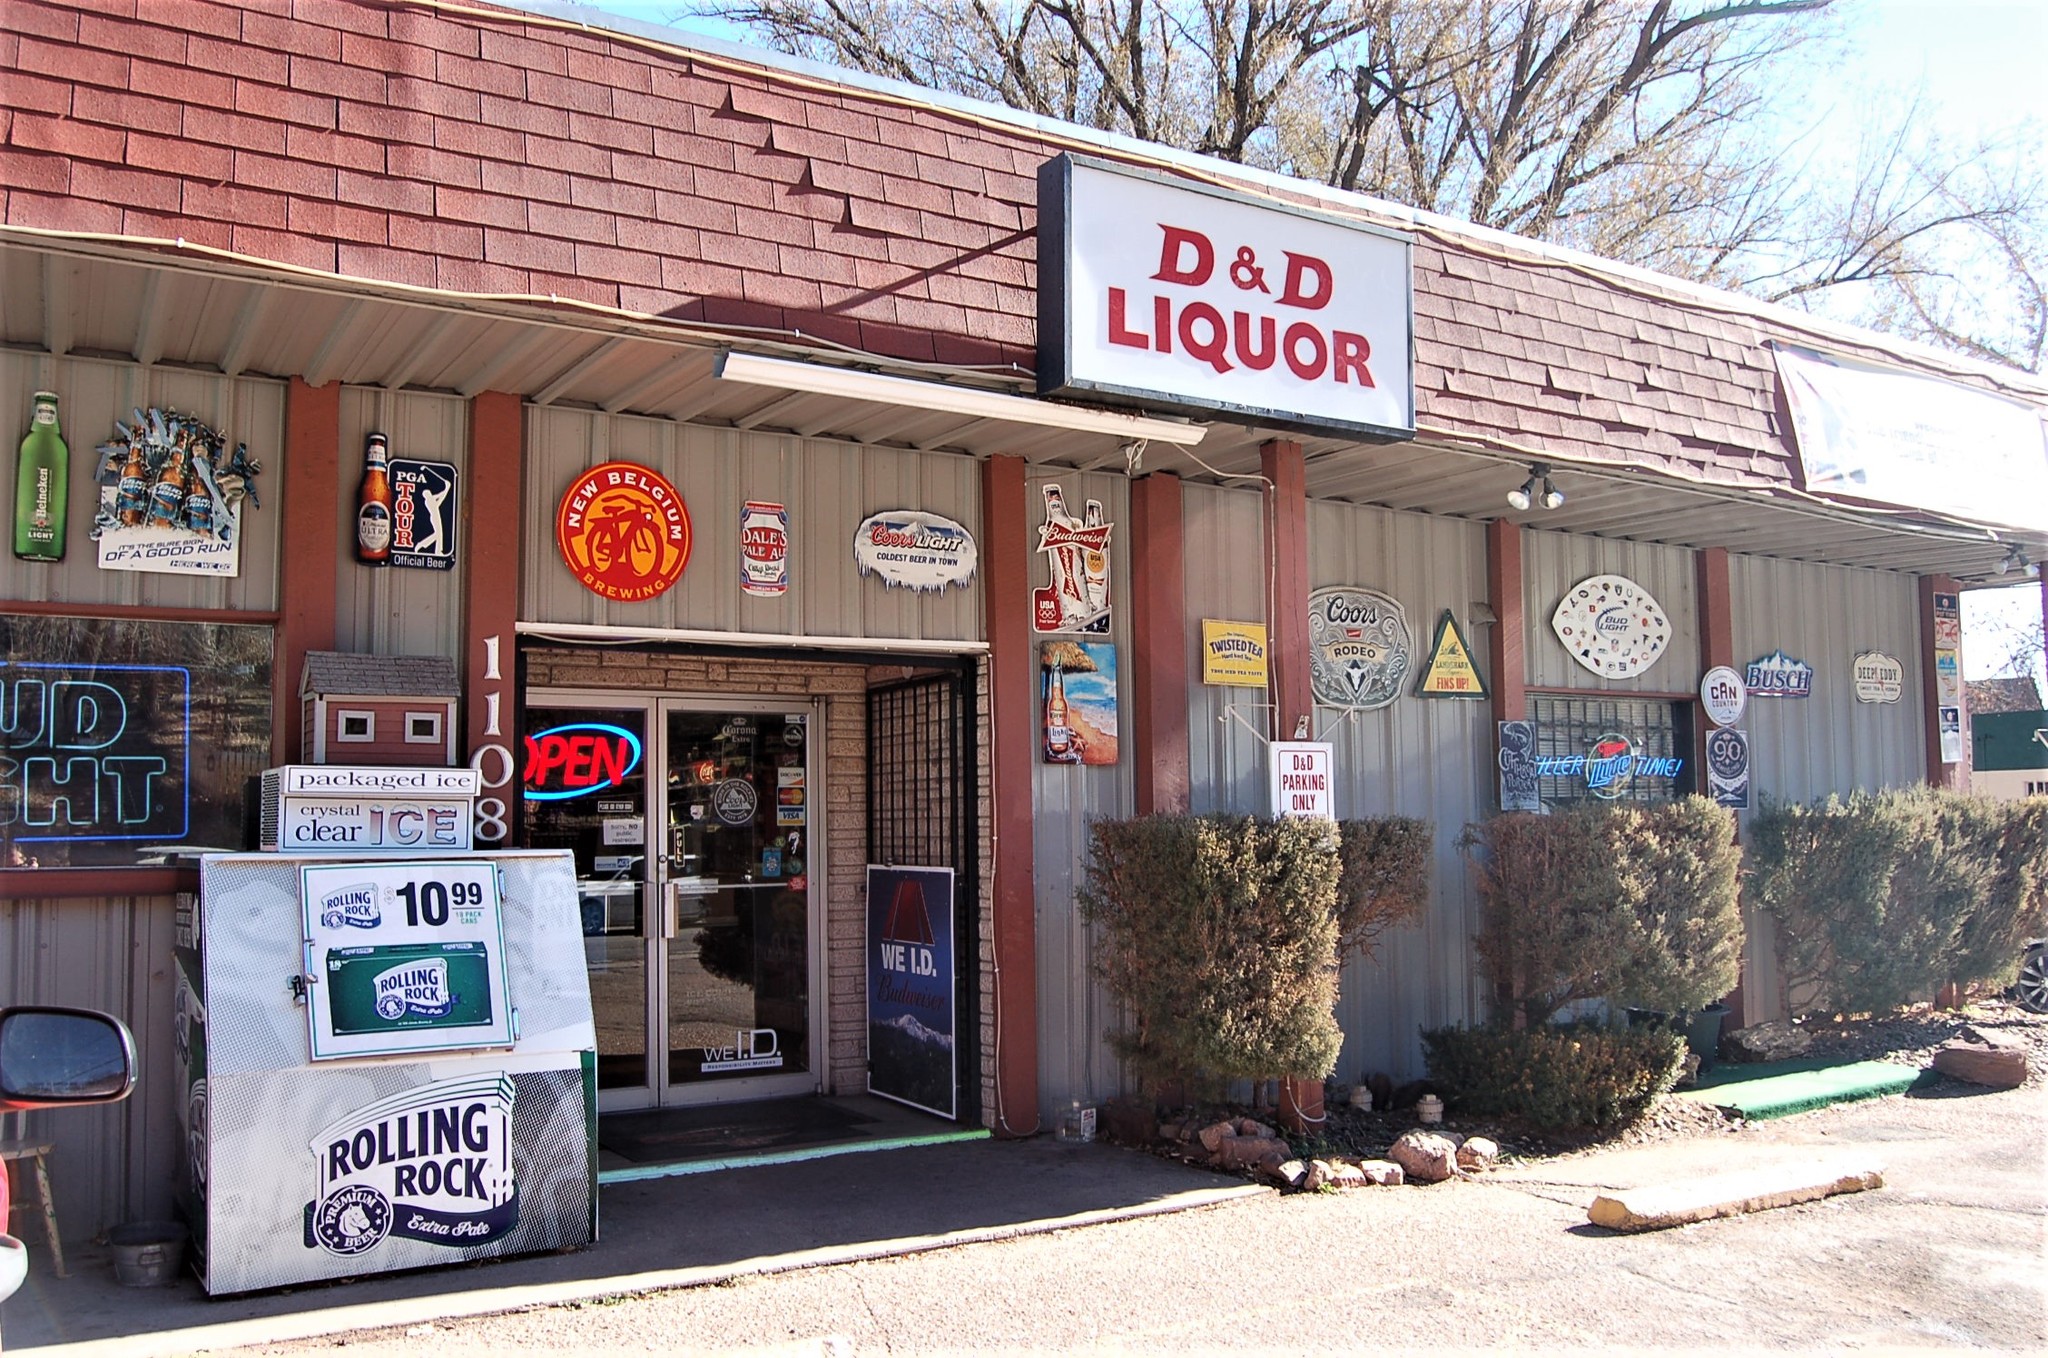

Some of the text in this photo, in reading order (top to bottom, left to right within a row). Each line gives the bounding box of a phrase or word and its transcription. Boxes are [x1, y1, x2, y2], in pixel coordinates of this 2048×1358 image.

[1108, 286, 1375, 388] LIQUOR
[396, 471, 427, 483] PGA
[36, 468, 48, 518] Heineken
[395, 482, 415, 547] TOUR
[568, 472, 682, 539] NEW BELGIUM
[28, 531, 54, 539] LIGHT
[742, 528, 787, 547] DALE'S
[871, 524, 963, 551] Coors LIGHT
[105, 542, 232, 561] OF A GOOD RUN
[743, 545, 766, 556] PALE
[876, 552, 907, 561] COLDEST
[909, 555, 926, 563] BEER
[938, 558, 958, 567] TOWN
[393, 554, 447, 568] Official Beer
[583, 573, 665, 598] BREWING
[1040, 600, 1055, 609] USA
[1327, 596, 1378, 624] Coors
[1599, 623, 1629, 632] LIGHT
[1605, 616, 1628, 625] BUD
[1209, 640, 1263, 659] TWISTED TEA
[1334, 646, 1376, 659] RODEO
[1748, 666, 1811, 689] BUSCH
[1858, 666, 1897, 681] DEEP EDDY
[1437, 677, 1470, 690] FINS UP!
[1711, 682, 1737, 700] CAN
[1712, 700, 1738, 708] COUNTRY
[0, 679, 126, 749] UD
[721, 725, 757, 737] Corona
[1714, 741, 1741, 761] 90
[1293, 754, 1313, 771] D&D
[1634, 755, 1682, 777] TIME!
[300, 772, 470, 790] packaged ice
[1283, 774, 1325, 791] PARKING
[301, 805, 360, 818] crystal
[1292, 794, 1316, 811] ONLY
[369, 804, 457, 845] ICE
[783, 812, 801, 820] VISA
[296, 820, 362, 842] clear
[327, 892, 371, 909] ROLLING
[344, 904, 372, 917] ROCK
[881, 943, 937, 977] WE I.D.
[380, 968, 438, 993] ROLLING
[405, 986, 439, 1002] ROCK
[876, 975, 945, 1010] Budweiser
[704, 1028, 781, 1061] WE I.D.
[329, 1103, 488, 1182] ROLLING
[395, 1158, 489, 1201] ROCK
[325, 1191, 377, 1225] PREMIUM
[407, 1212, 490, 1236] Extra Pale
[344, 1227, 378, 1247] BEER
